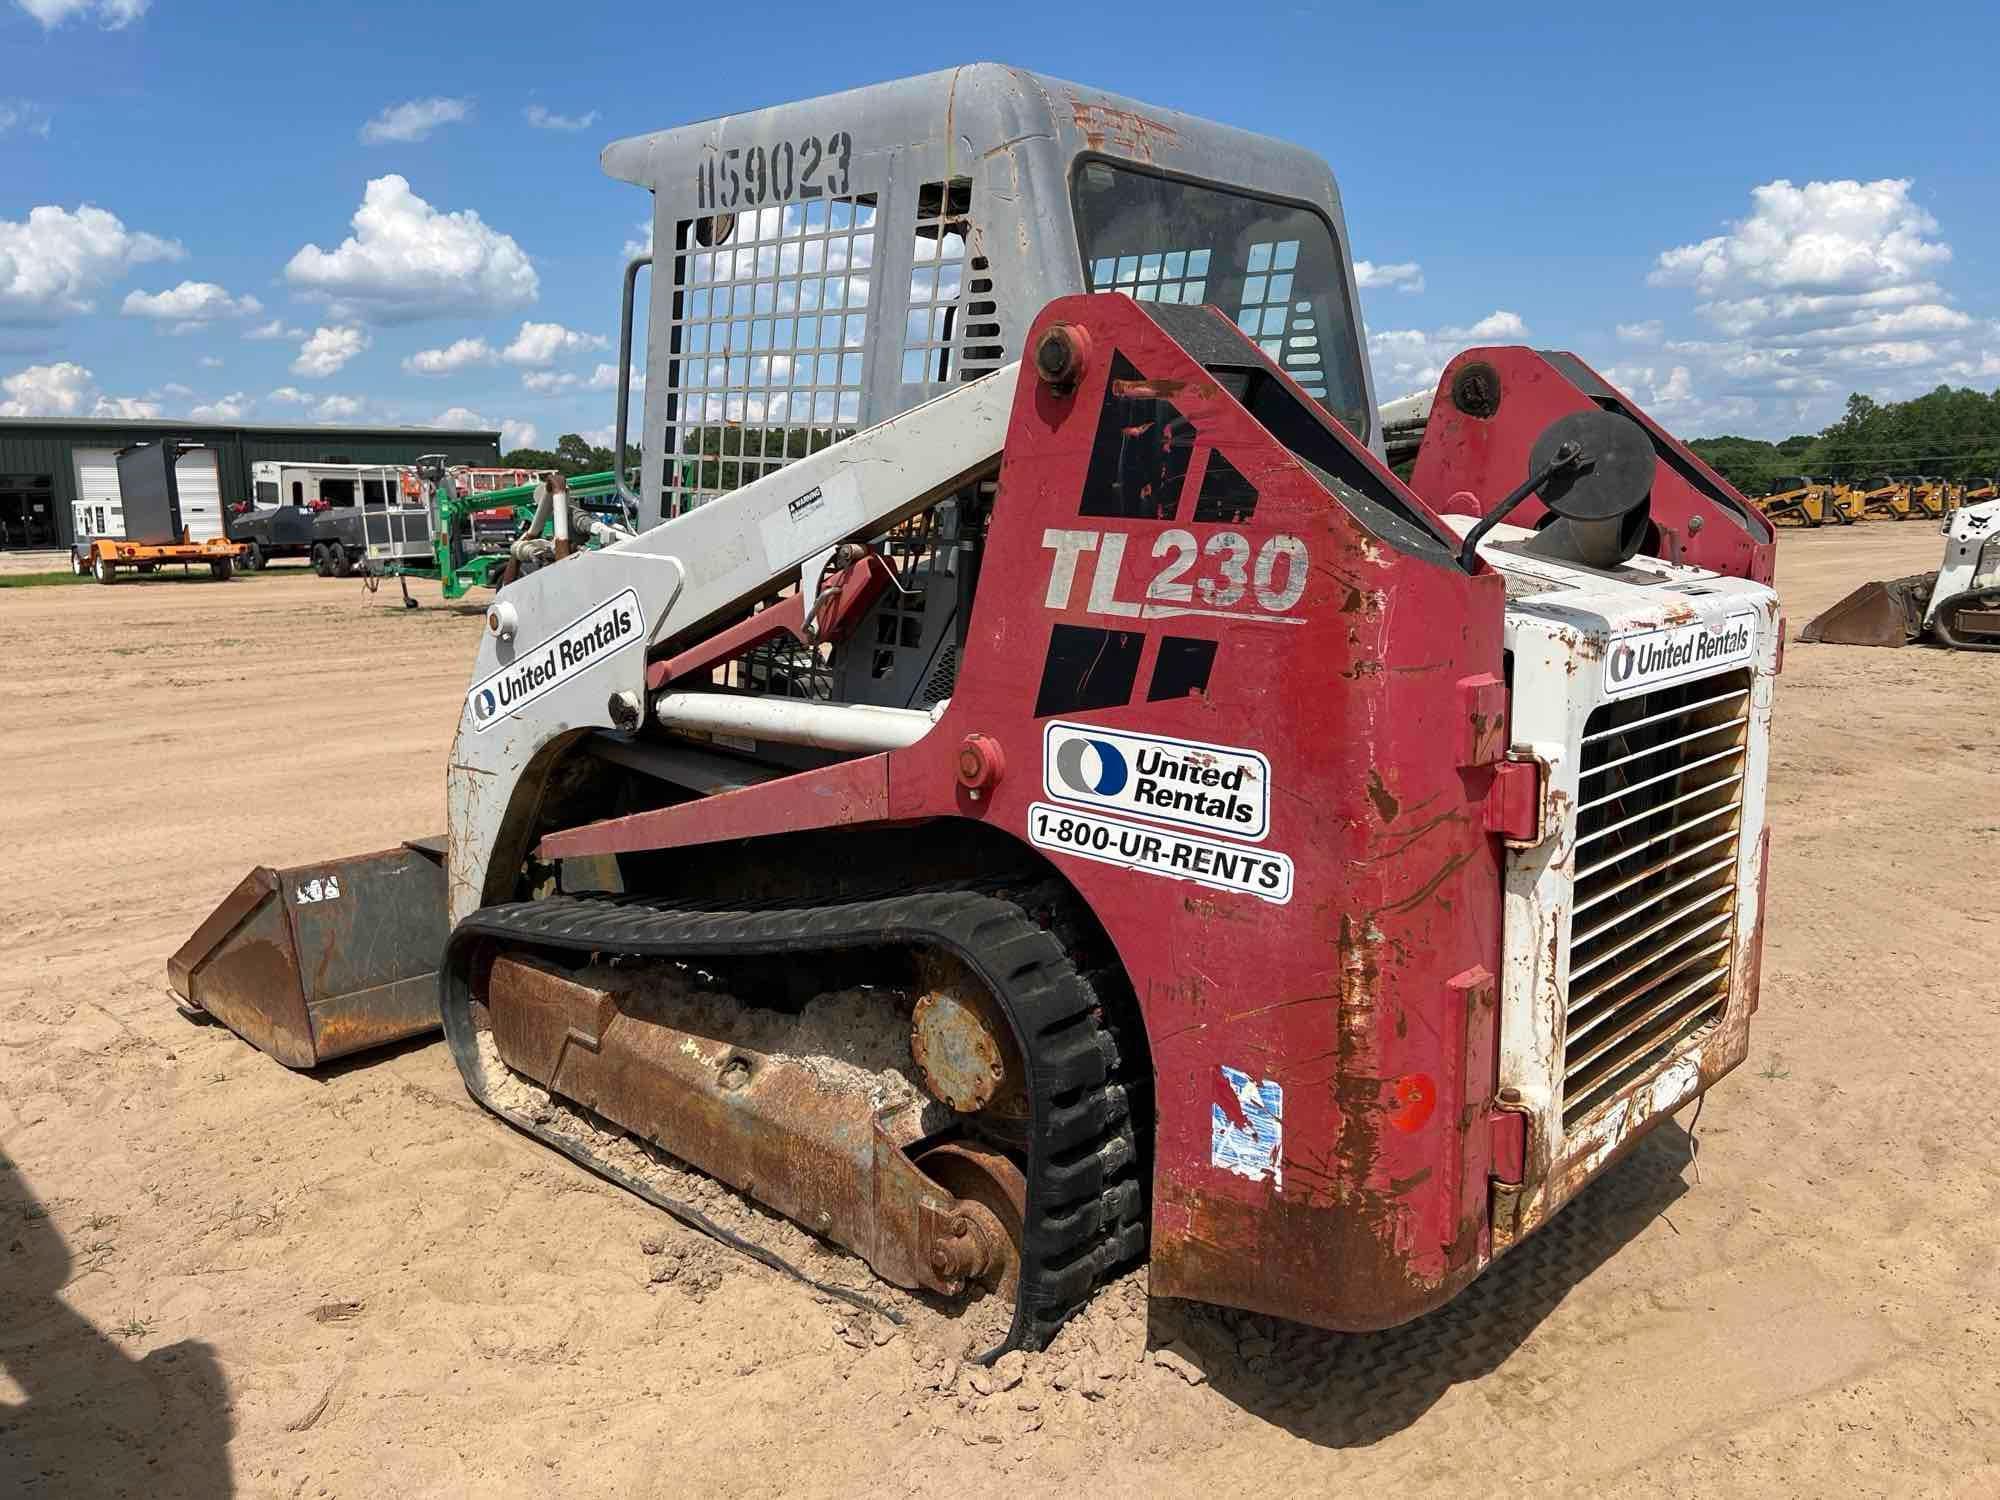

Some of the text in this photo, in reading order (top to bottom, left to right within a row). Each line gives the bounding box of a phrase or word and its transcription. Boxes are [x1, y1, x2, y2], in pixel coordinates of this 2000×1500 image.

[794, 487, 821, 508] WARNING
[1042, 528, 1310, 619] TL230
[498, 609, 632, 706] United Rentals
[1638, 623, 1748, 675] United Rentals
[1136, 749, 1244, 791] United
[1134, 778, 1253, 823] Rentals
[1037, 814, 1282, 889] 1-800-UR-RENTS
